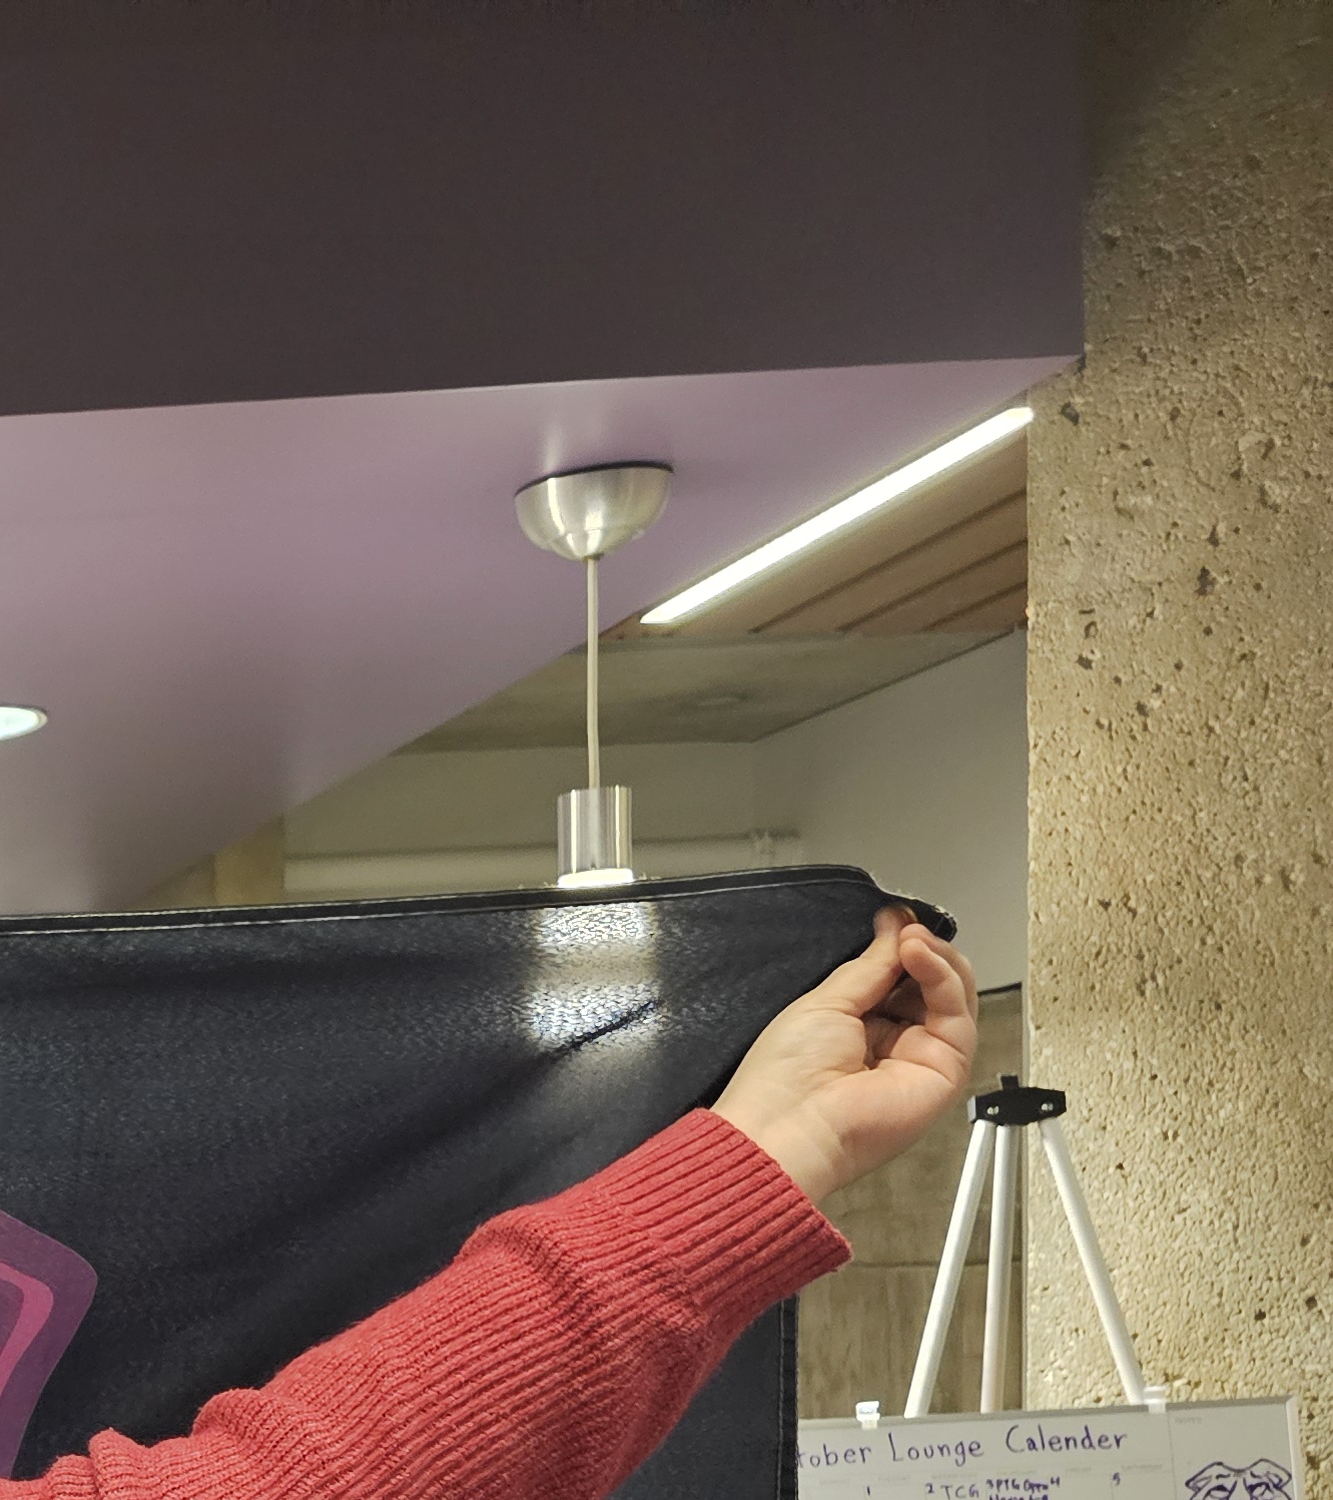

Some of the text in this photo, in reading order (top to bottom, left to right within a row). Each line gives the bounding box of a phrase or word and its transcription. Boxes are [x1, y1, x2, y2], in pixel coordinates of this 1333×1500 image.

[887, 1431, 984, 1468] Lounge
[1005, 1424, 1128, 1453] Calender
[940, 1483, 980, 1500] TCG
